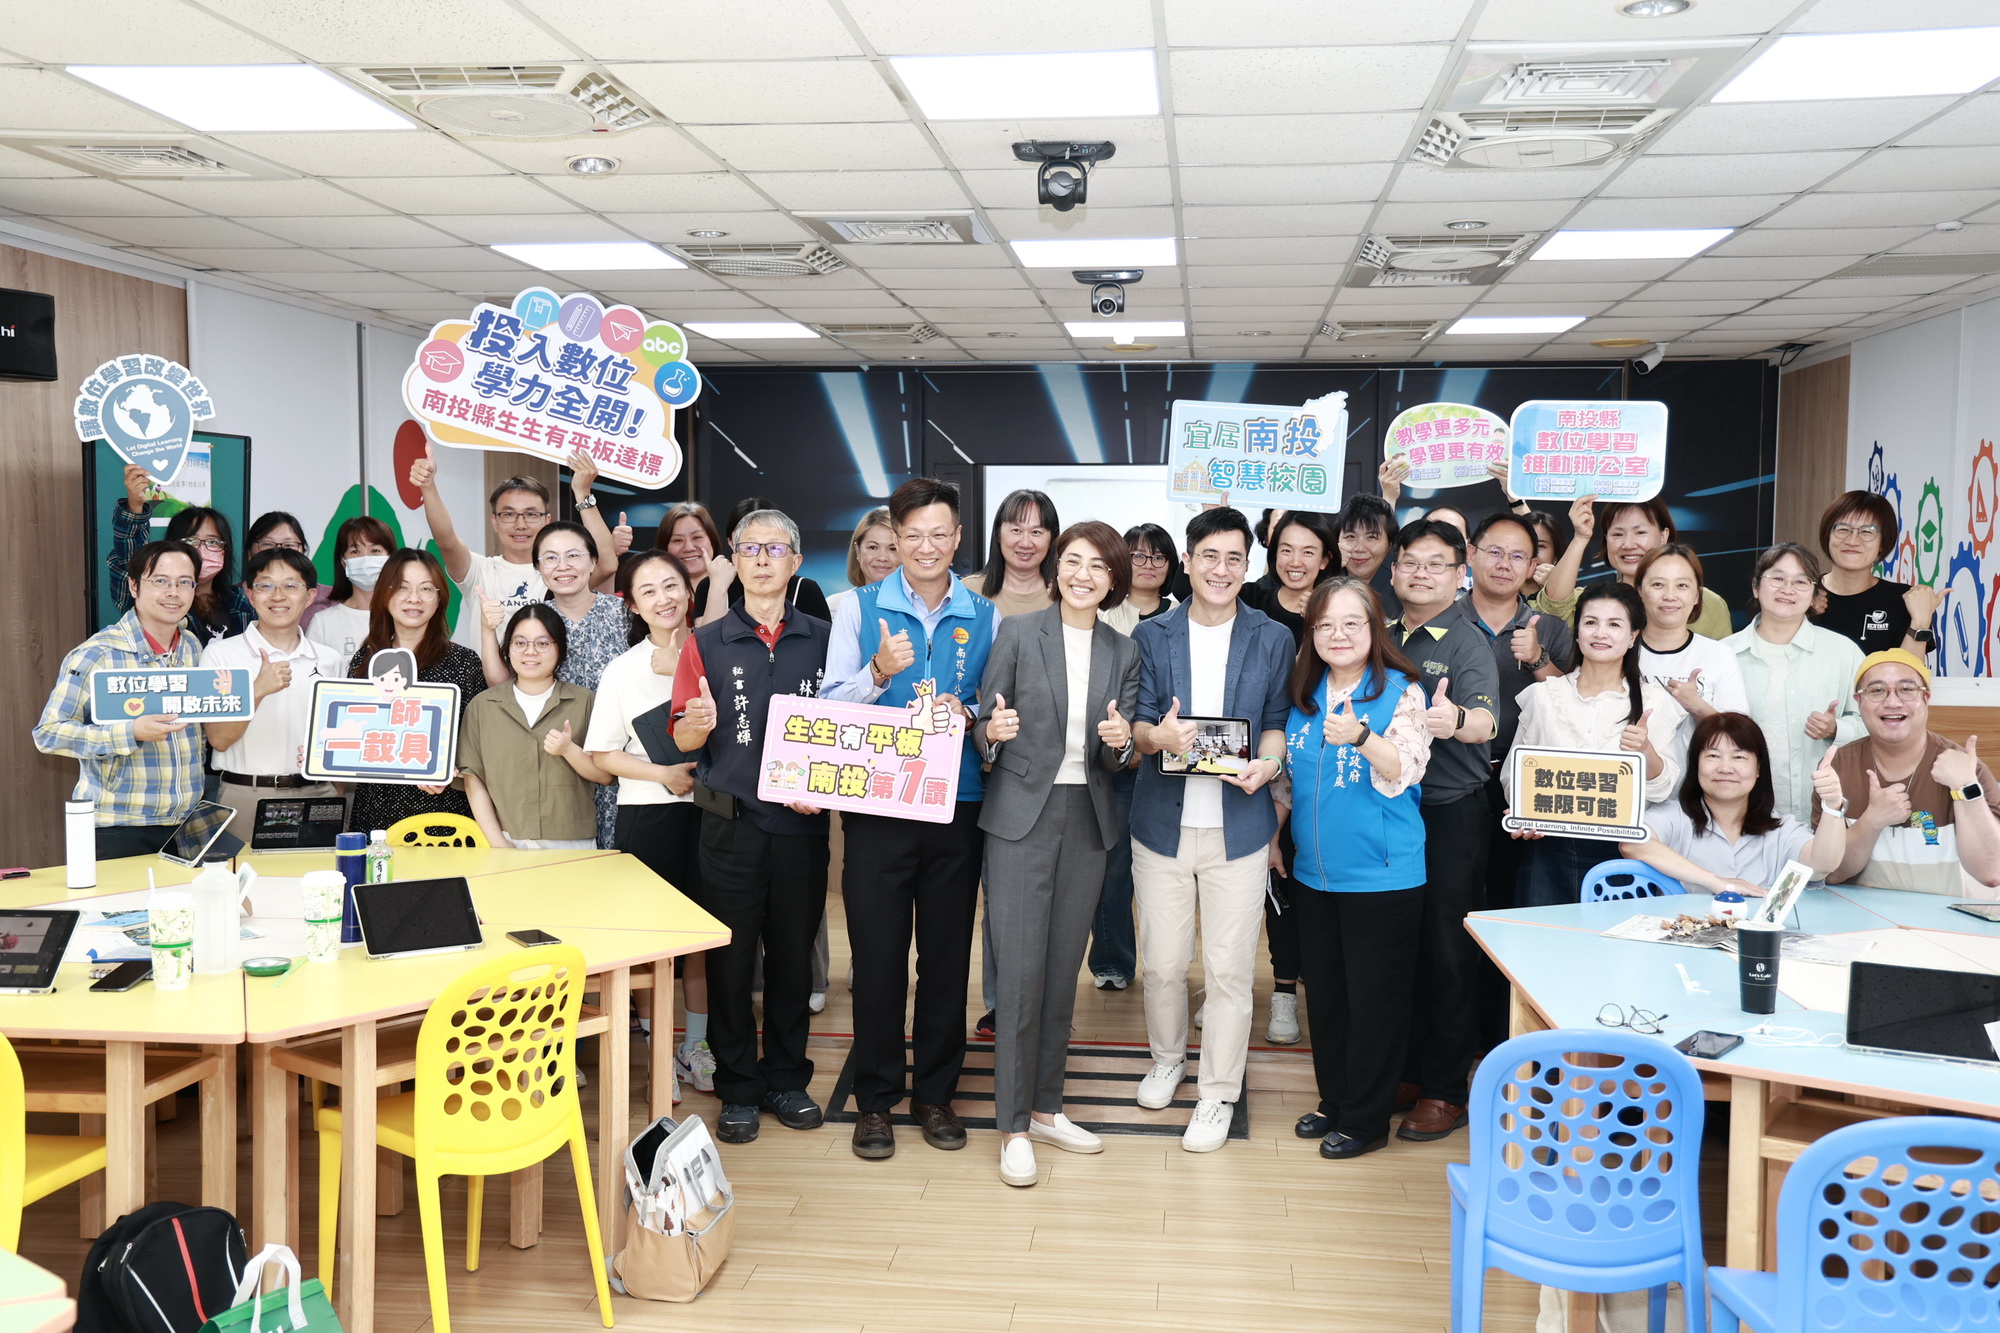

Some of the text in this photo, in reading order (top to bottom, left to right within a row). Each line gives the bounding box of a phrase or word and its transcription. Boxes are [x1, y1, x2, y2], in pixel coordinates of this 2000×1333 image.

[466, 309, 636, 393] 投入數位
[642, 337, 681, 354] abc
[77, 357, 212, 438] 讓數位學習改變世界
[473, 361, 645, 436] 學力全開!
[422, 388, 664, 477] 南投縣生生有平板達標
[1396, 418, 1490, 446] 教學更多元
[1558, 410, 1619, 427] 南投縣
[131, 448, 154, 457] Change
[166, 443, 183, 451] World
[137, 441, 156, 450] Digital
[157, 437, 183, 447] Learning
[1185, 418, 1321, 458] 宜居南投
[1537, 432, 1636, 451] 數位學習
[1409, 442, 1505, 466] 學習更有效
[1523, 455, 1648, 475] 推動辦公室
[1209, 460, 1327, 495] 智慧校園
[107, 675, 188, 694] 數位學習
[162, 695, 242, 714] 開啟未來
[347, 699, 422, 727] 一師
[733, 694, 752, 746] 許志輝
[327, 732, 431, 765] 一載具
[783, 714, 925, 758] 生生有平板
[807, 757, 949, 806] 南投第1讚
[1334, 747, 1348, 788] 教育處
[1534, 768, 1618, 793] 數位學習
[1533, 793, 1618, 818] 無限可能
[1511, 820, 1533, 828] Digital
[1597, 827, 1640, 836] Possibilities
